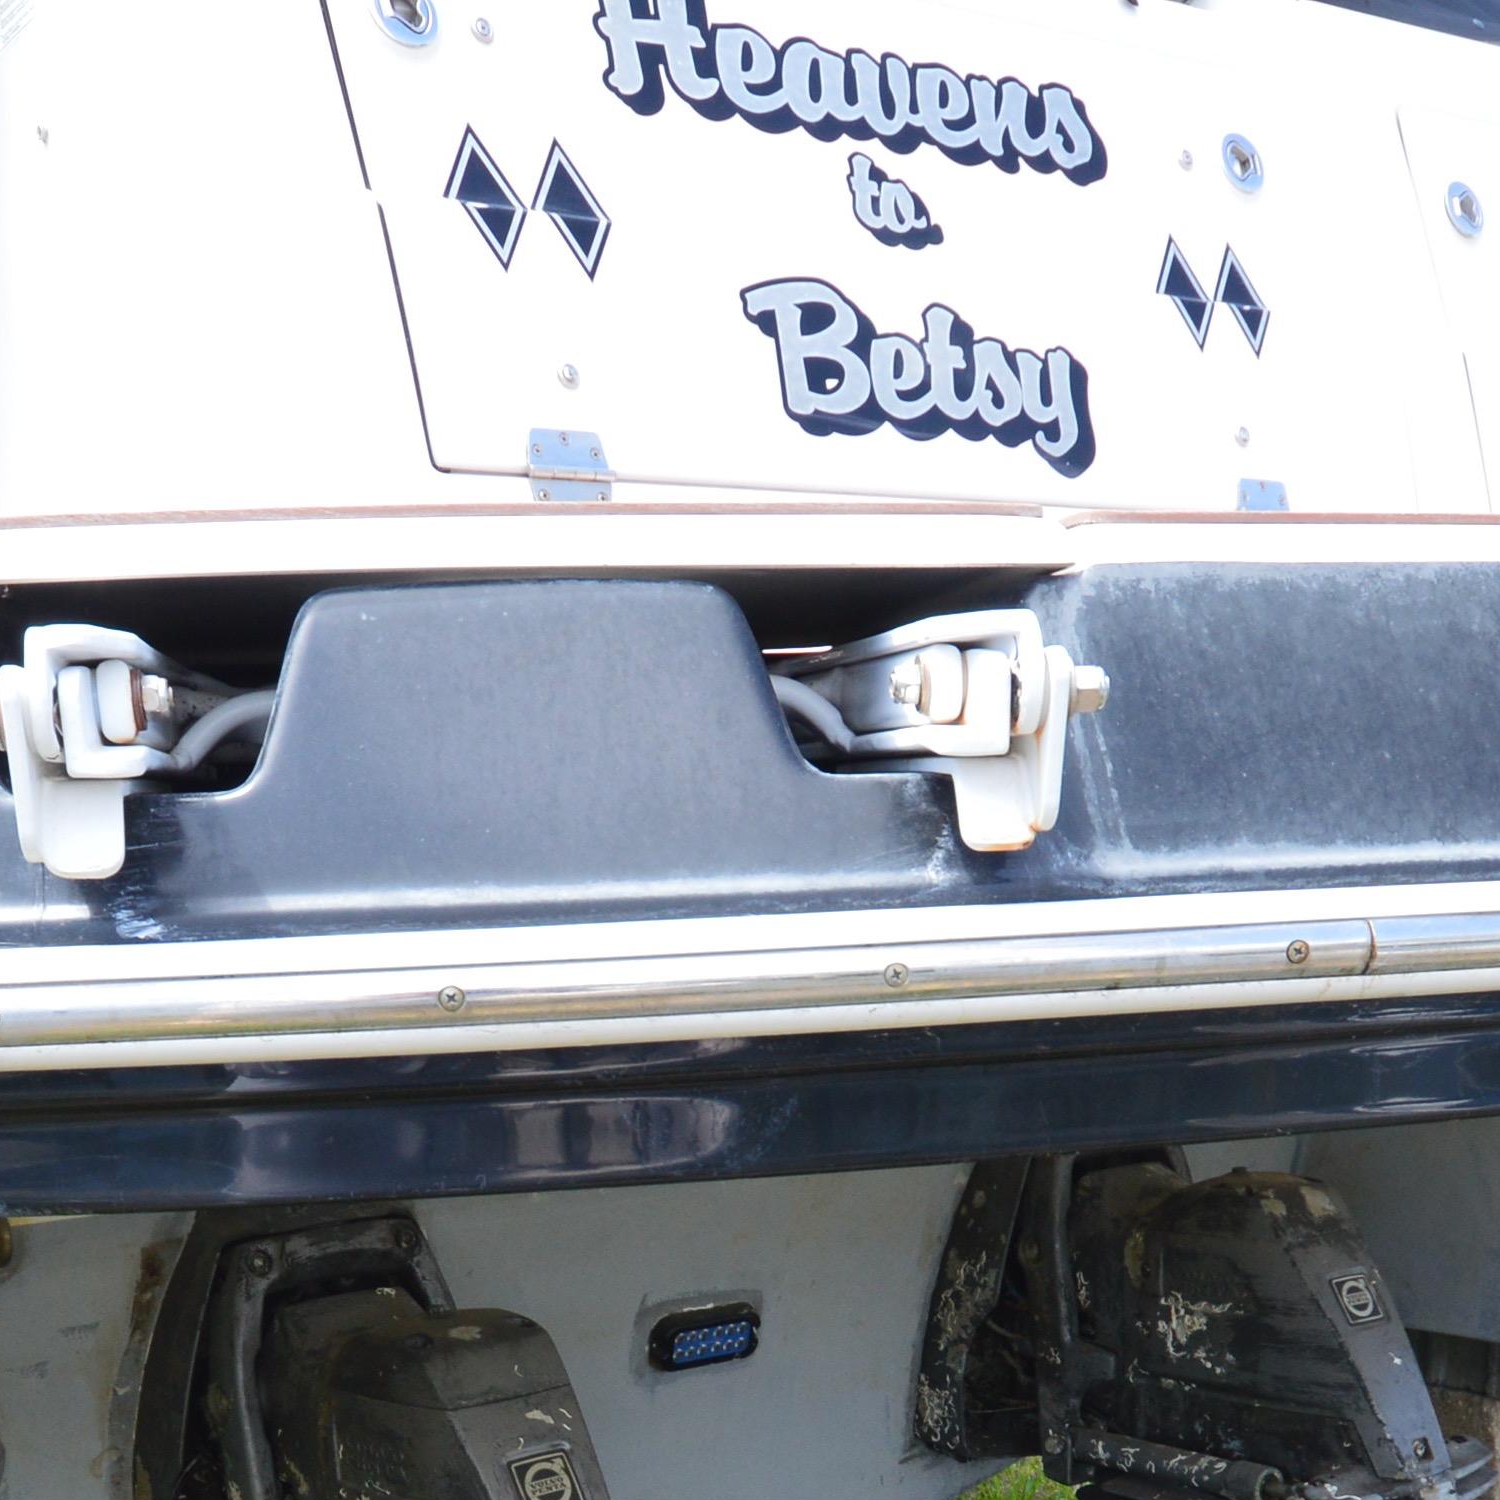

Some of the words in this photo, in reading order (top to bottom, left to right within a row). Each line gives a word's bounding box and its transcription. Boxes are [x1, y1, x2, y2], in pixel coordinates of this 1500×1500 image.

[593, 0, 1107, 185] Heavens
[848, 152, 943, 249] to
[740, 277, 1095, 477] Betsy
